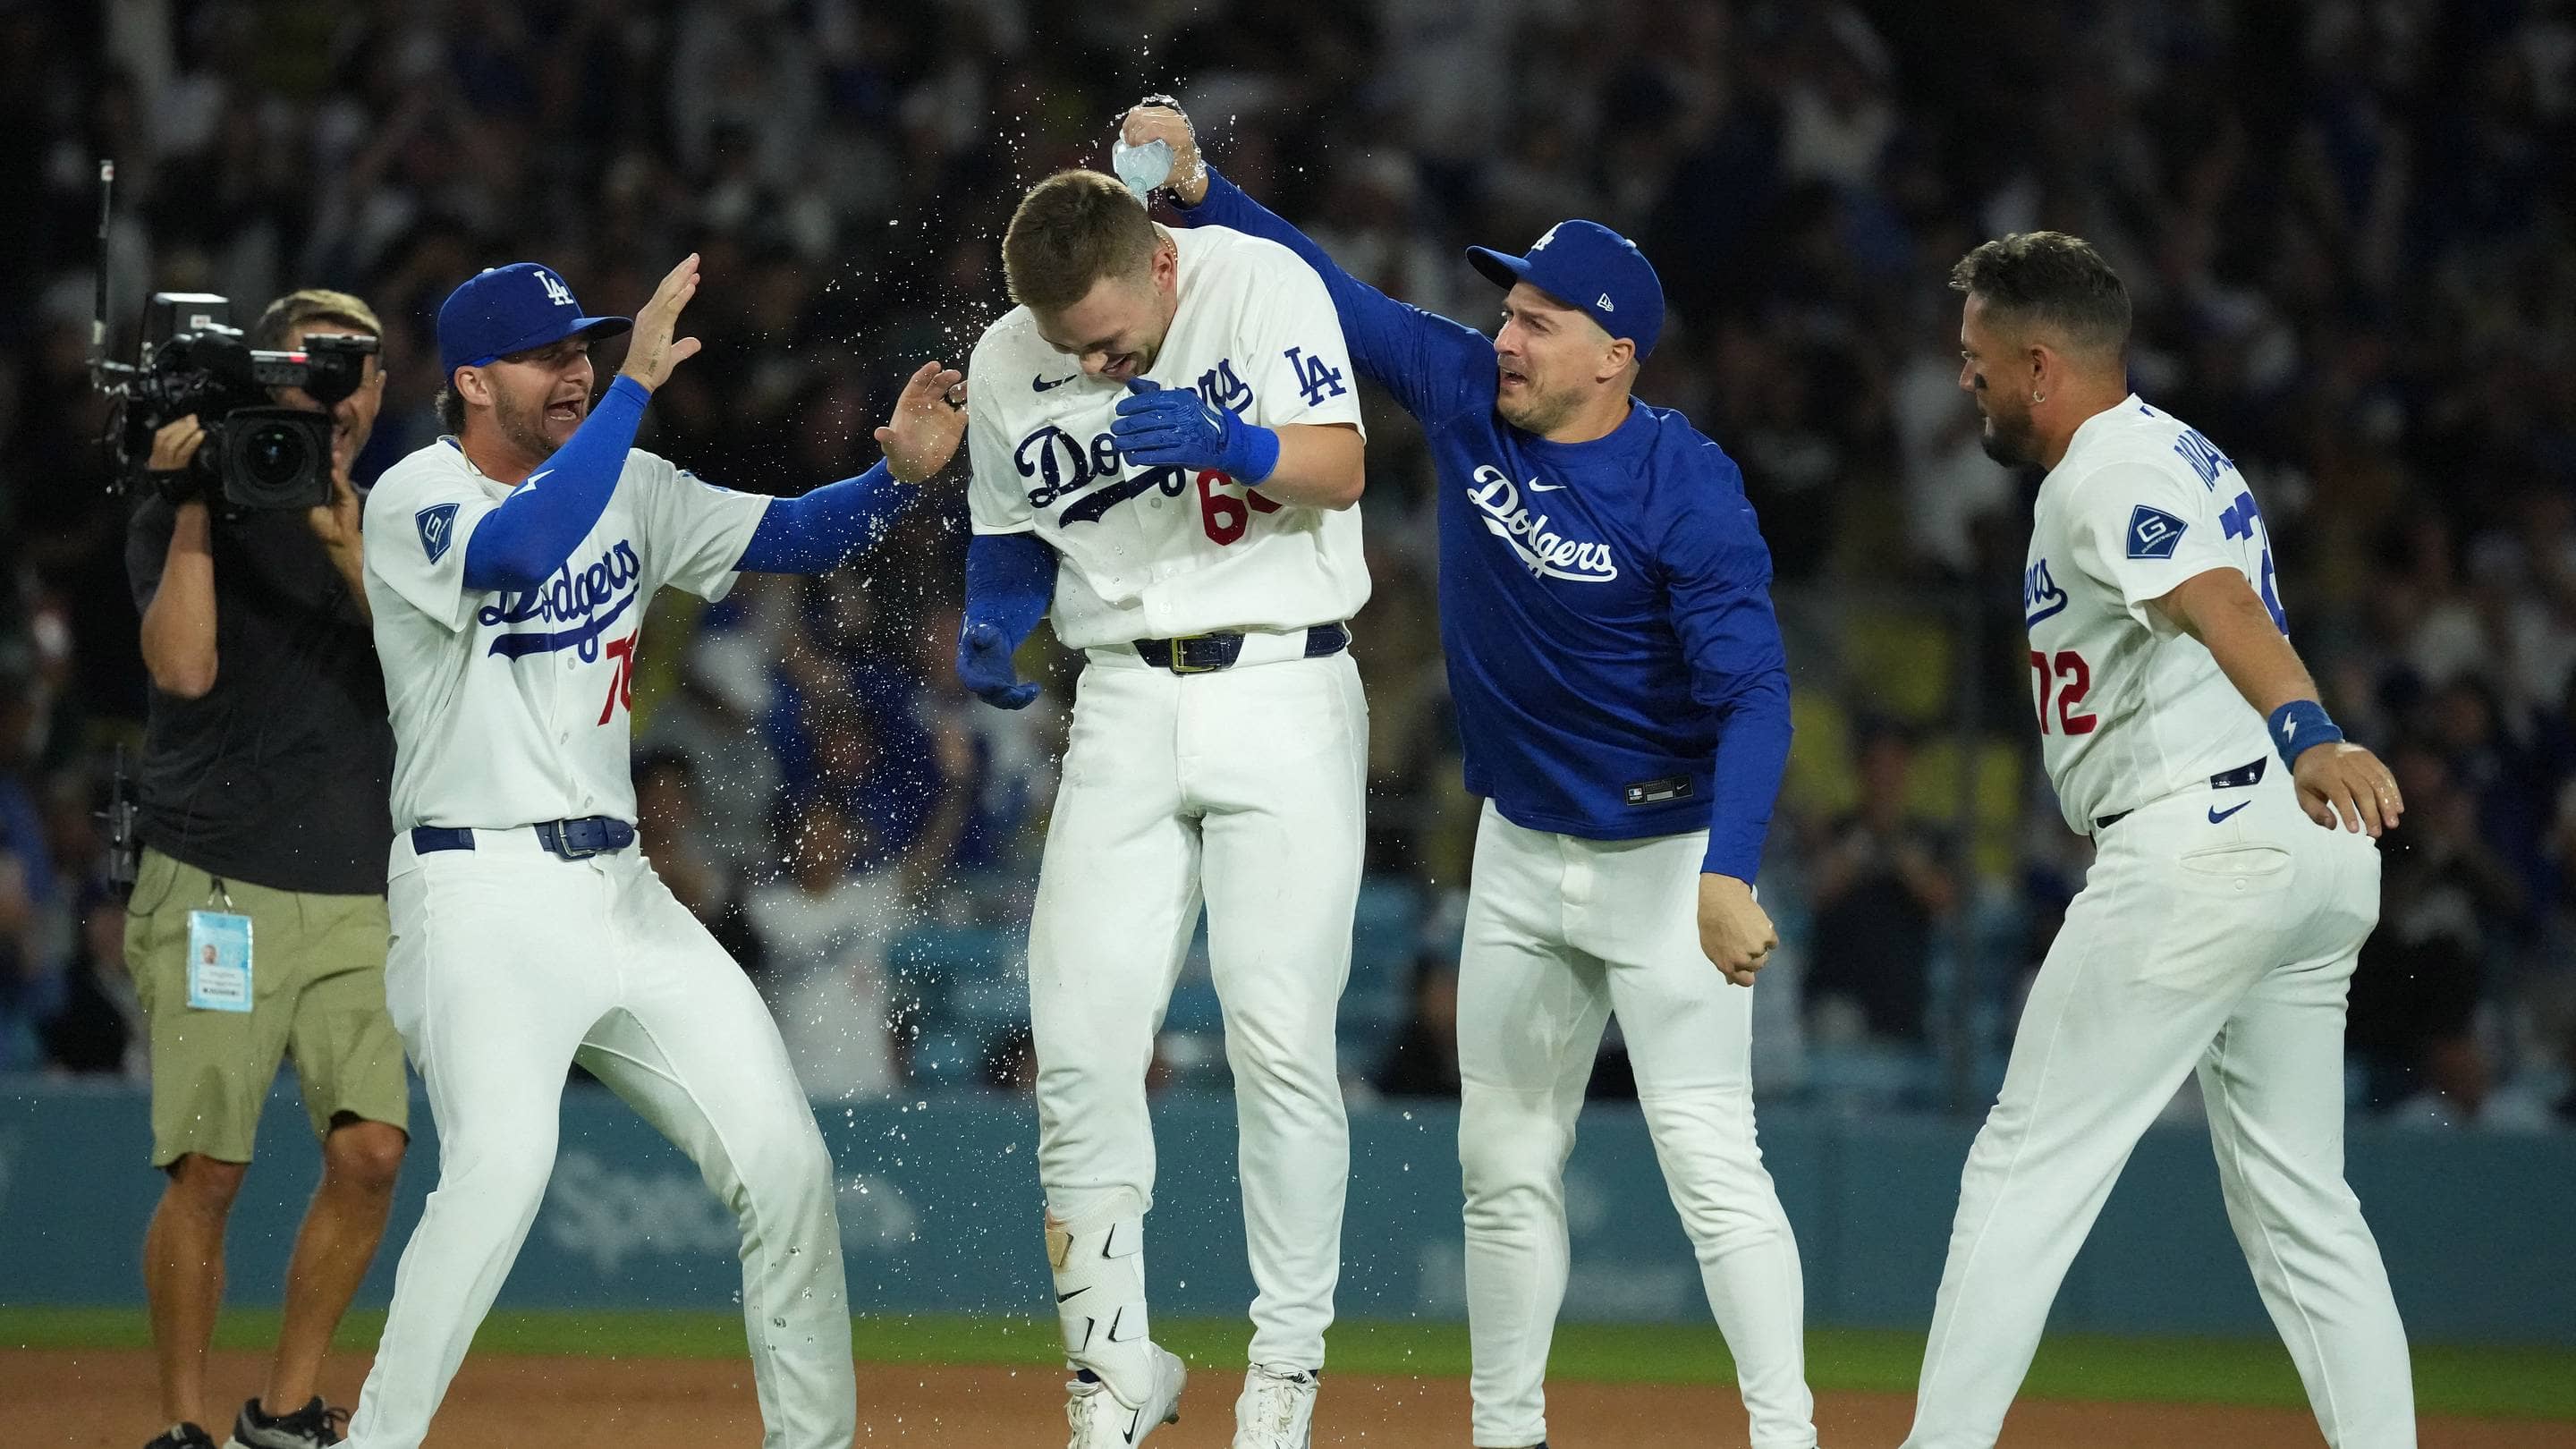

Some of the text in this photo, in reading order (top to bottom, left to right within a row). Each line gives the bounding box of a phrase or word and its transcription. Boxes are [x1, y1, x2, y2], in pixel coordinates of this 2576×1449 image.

[533, 270, 574, 306] LA
[1284, 346, 1347, 407] LA
[1013, 358, 1254, 510] Dors
[1196, 468, 1284, 547] 6
[1467, 464, 1618, 582] Dodgers
[2136, 515, 2166, 543] G
[478, 539, 640, 664] Ddgers
[2031, 650, 2097, 736] 72
